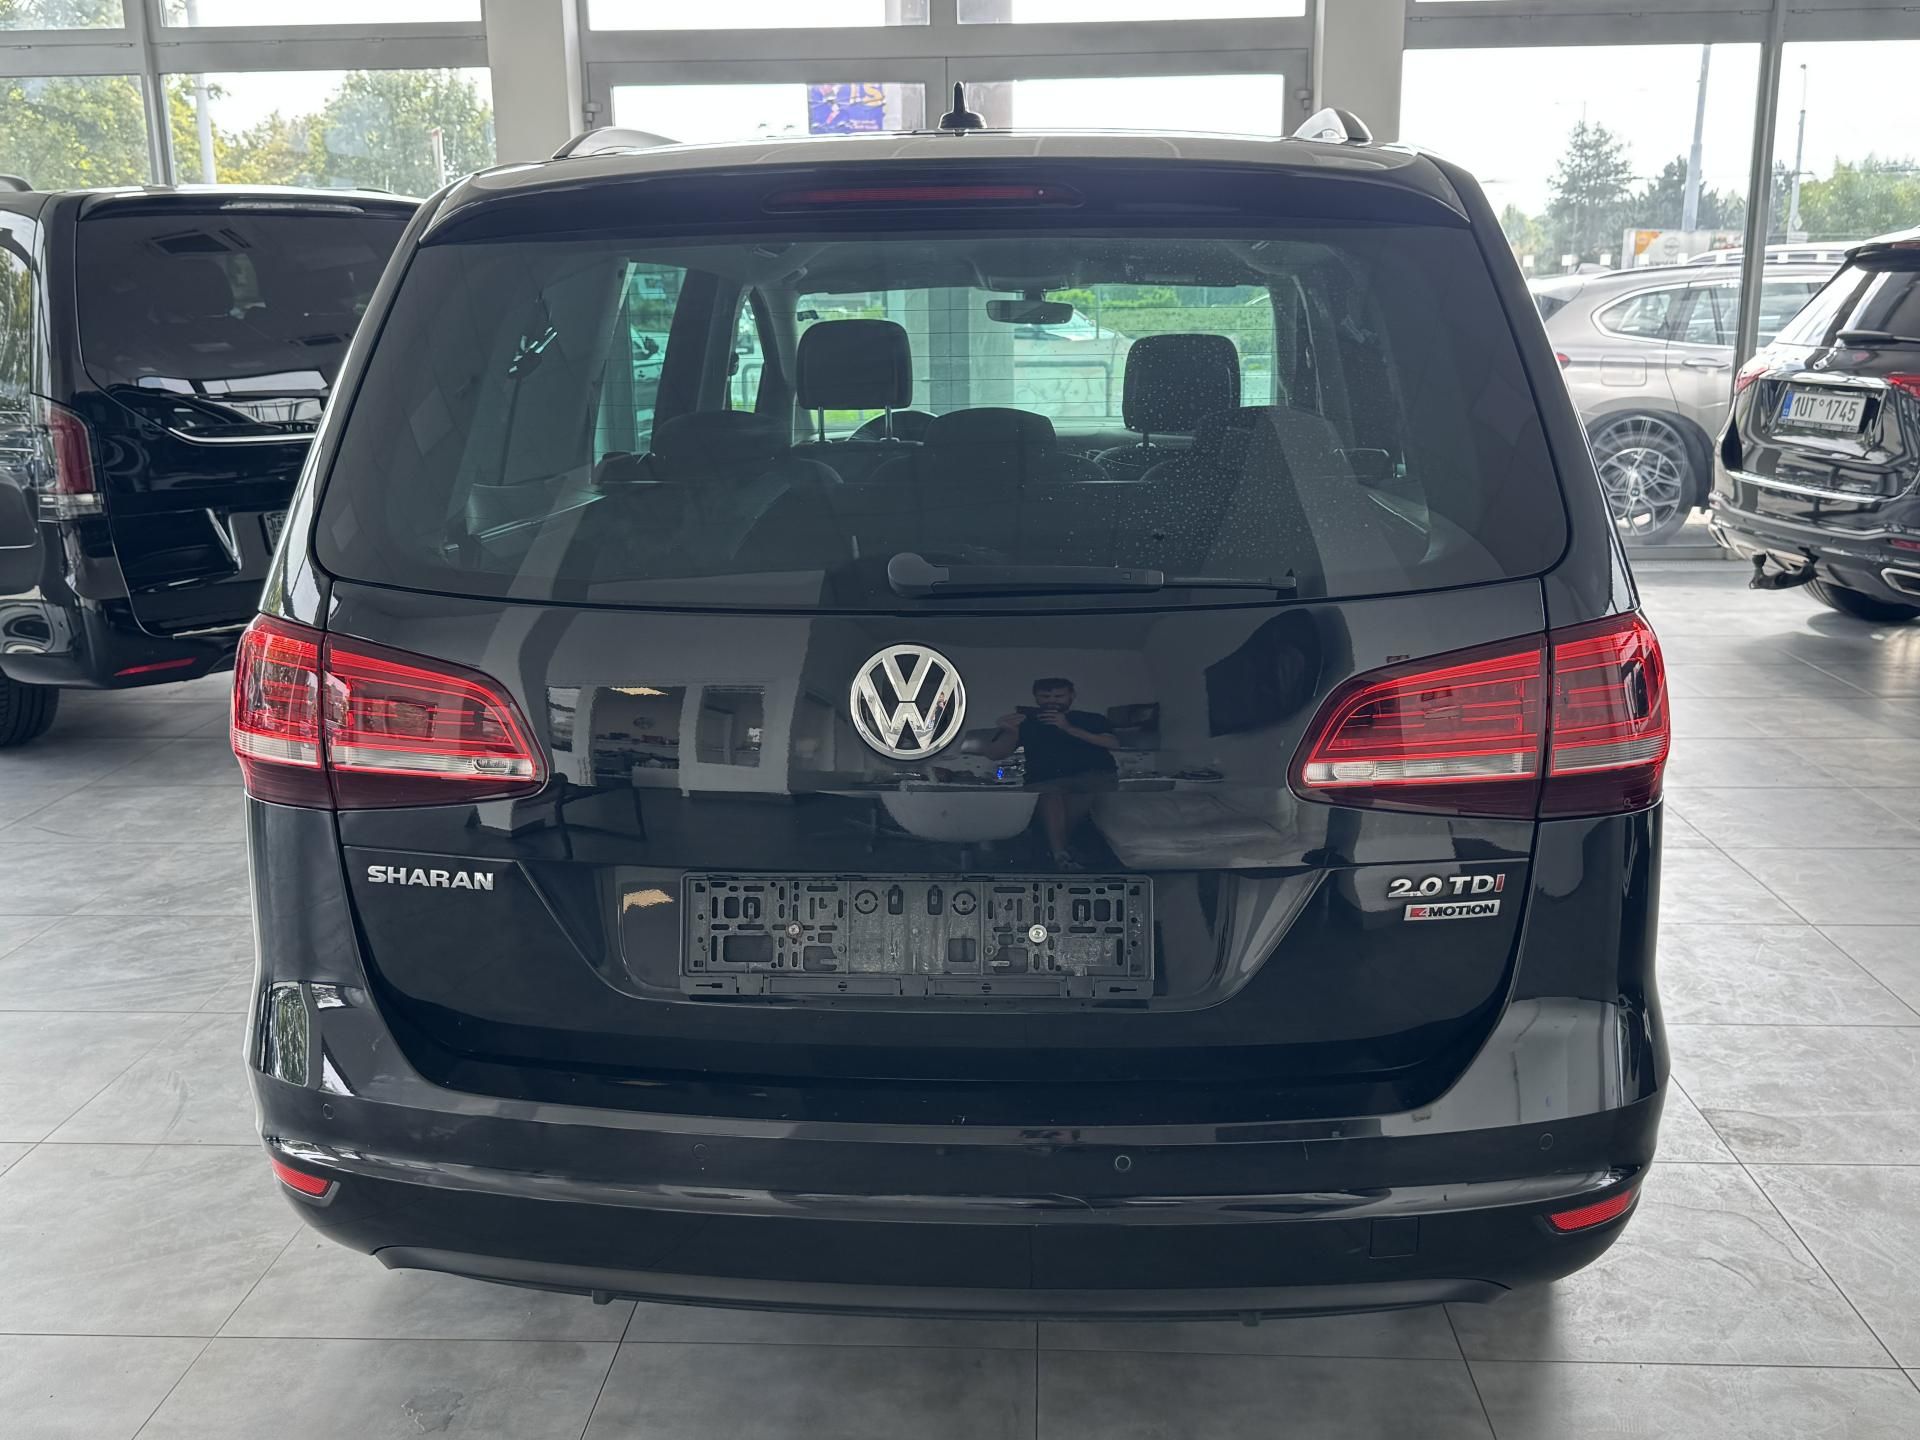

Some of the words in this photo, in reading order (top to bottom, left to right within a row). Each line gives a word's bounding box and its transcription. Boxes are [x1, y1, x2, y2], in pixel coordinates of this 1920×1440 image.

[1794, 396, 1817, 418] 1UT
[1825, 399, 1859, 422] 1745
[367, 865, 494, 891] SHARAN
[1387, 876, 1443, 898] 2.0
[1449, 873, 1505, 895] TDI
[1411, 904, 1495, 917] 4MOTION
